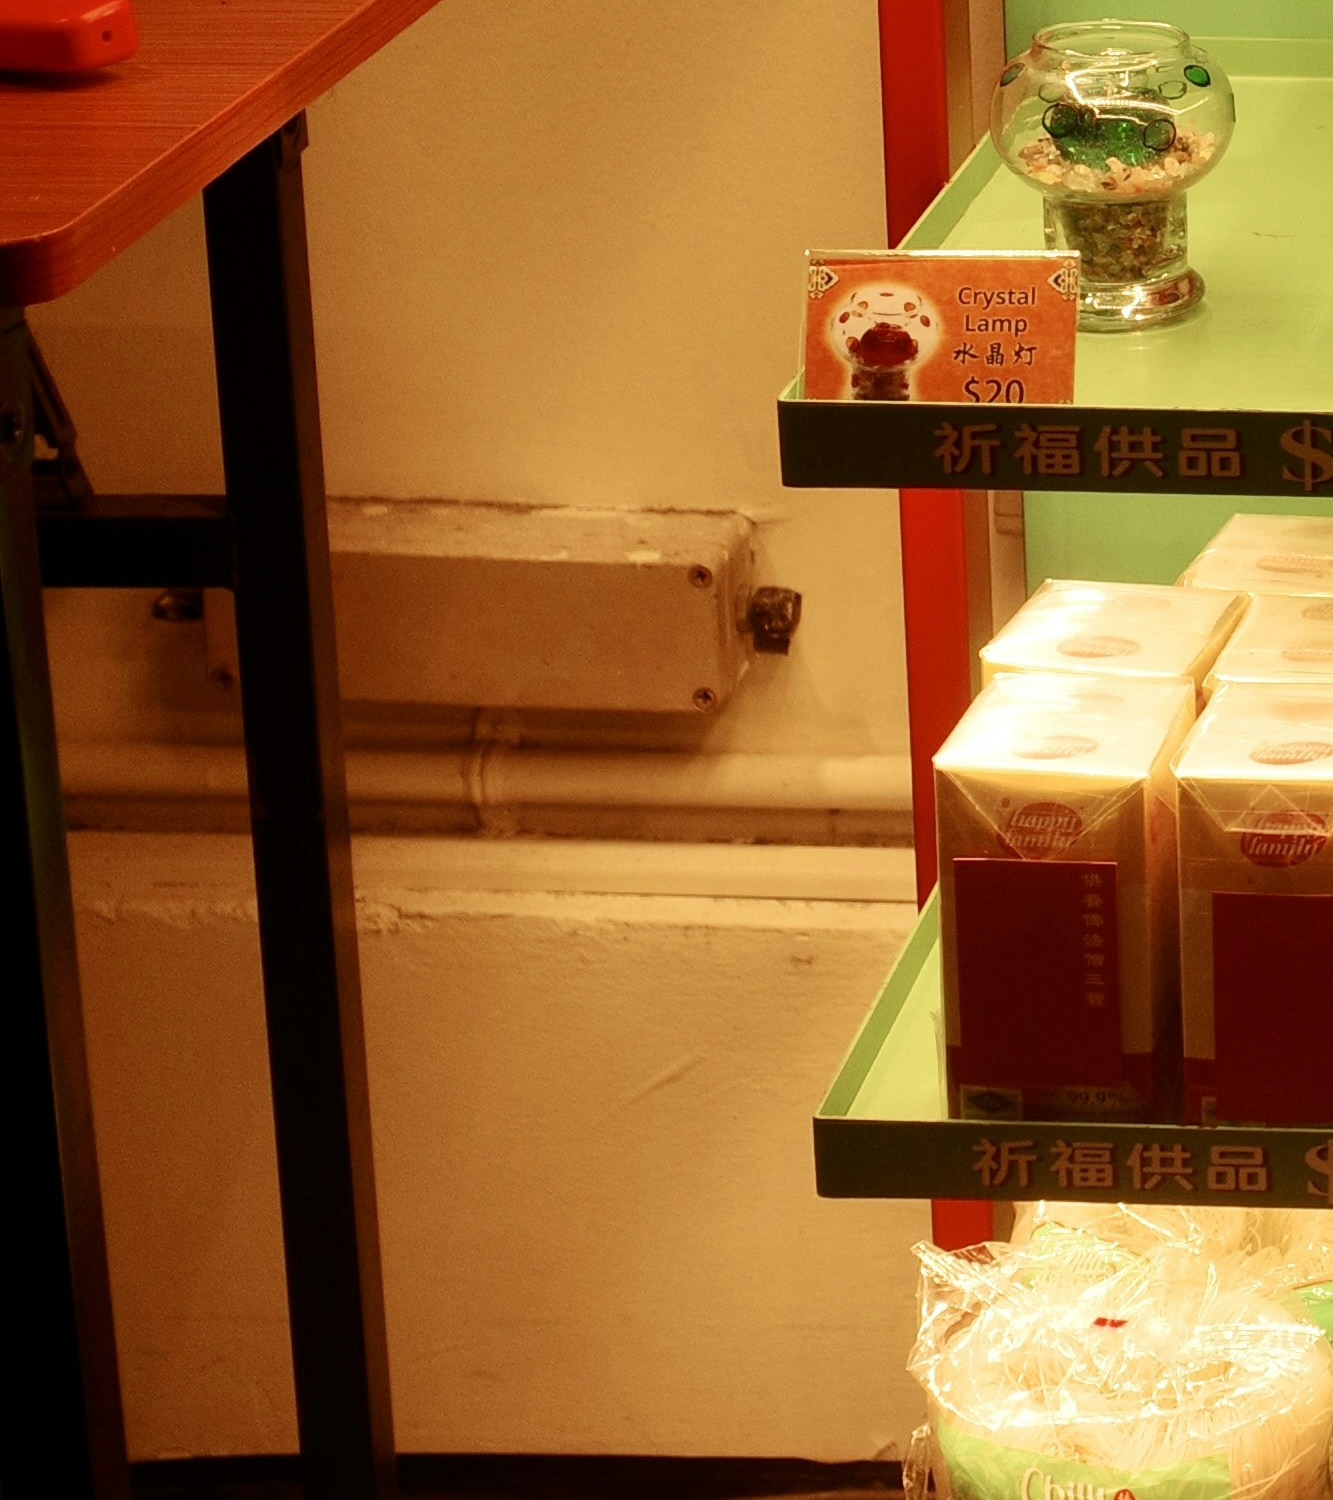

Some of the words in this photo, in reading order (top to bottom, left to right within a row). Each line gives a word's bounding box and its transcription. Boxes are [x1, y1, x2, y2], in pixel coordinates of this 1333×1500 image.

[957, 286, 1037, 311] Crystal
[965, 314, 1029, 339] Lamp
[952, 341, 1039, 367] 水晶灯
[963, 375, 1025, 403] $20
[932, 421, 1245, 482] 祈福供品
[971, 1139, 1270, 1194] 祈福供品
